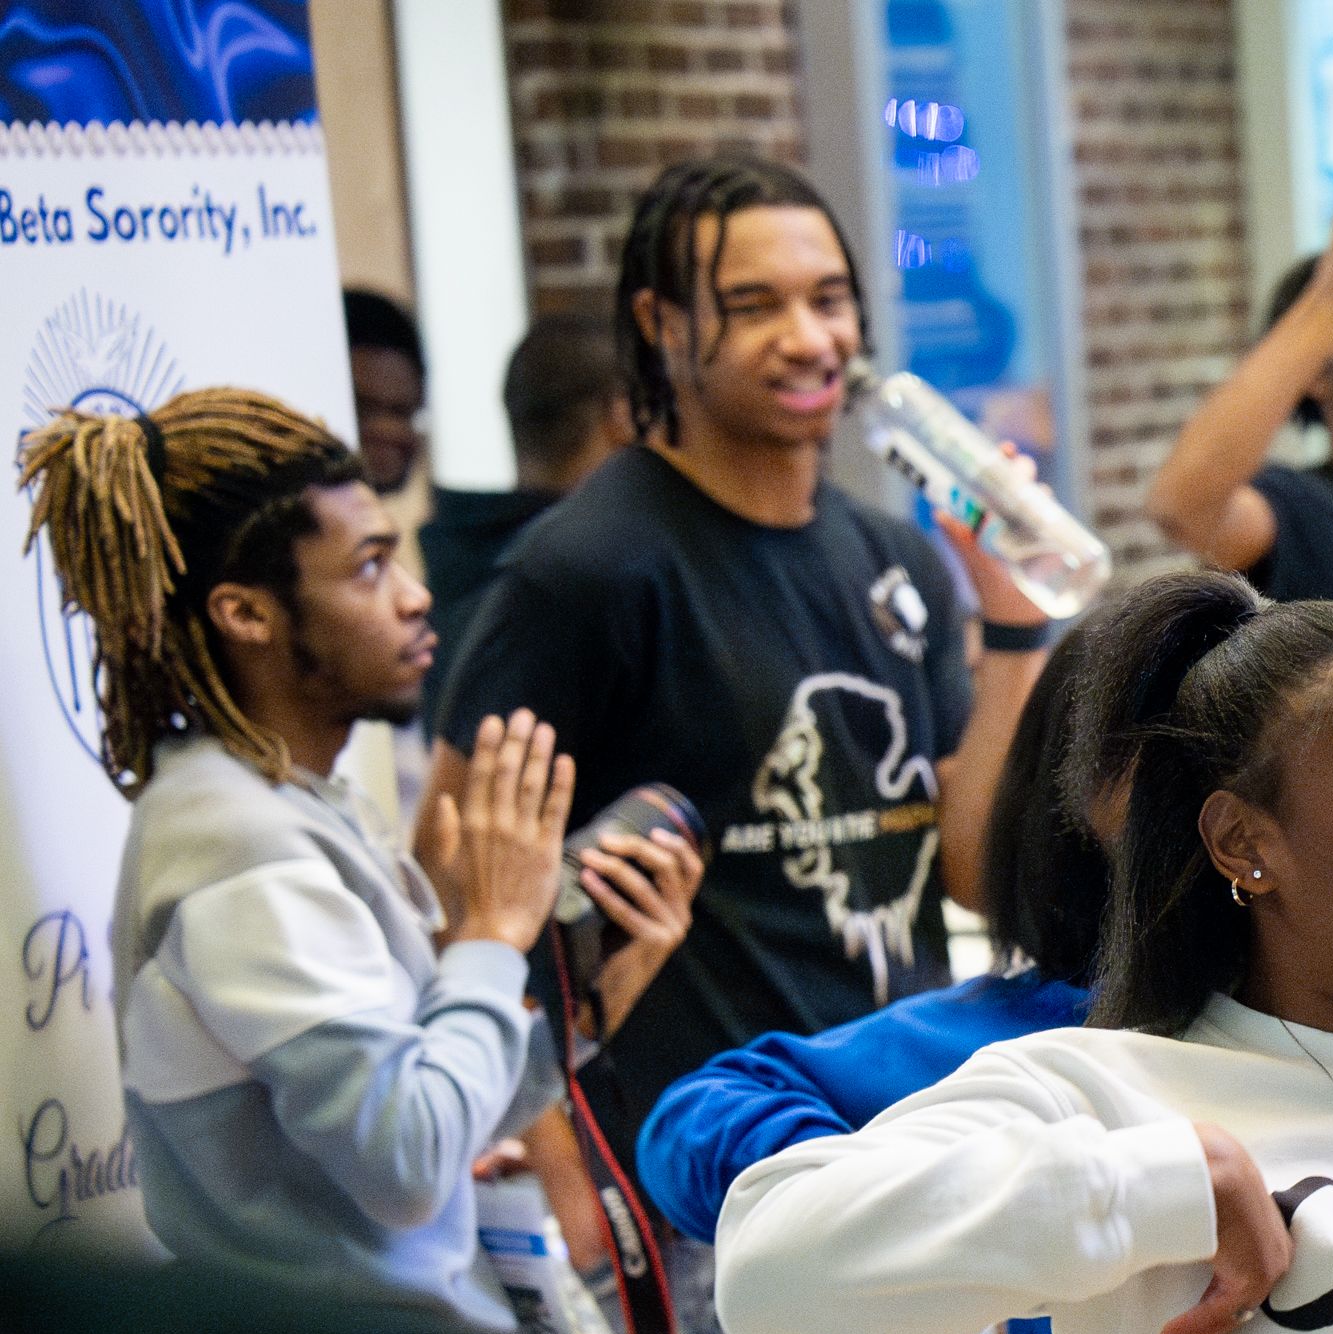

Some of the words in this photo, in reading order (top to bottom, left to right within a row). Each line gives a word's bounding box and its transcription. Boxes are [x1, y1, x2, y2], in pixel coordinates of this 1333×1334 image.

[0, 186, 74, 243] Beta
[86, 183, 251, 257] Sorority,
[258, 180, 317, 239] Inc.
